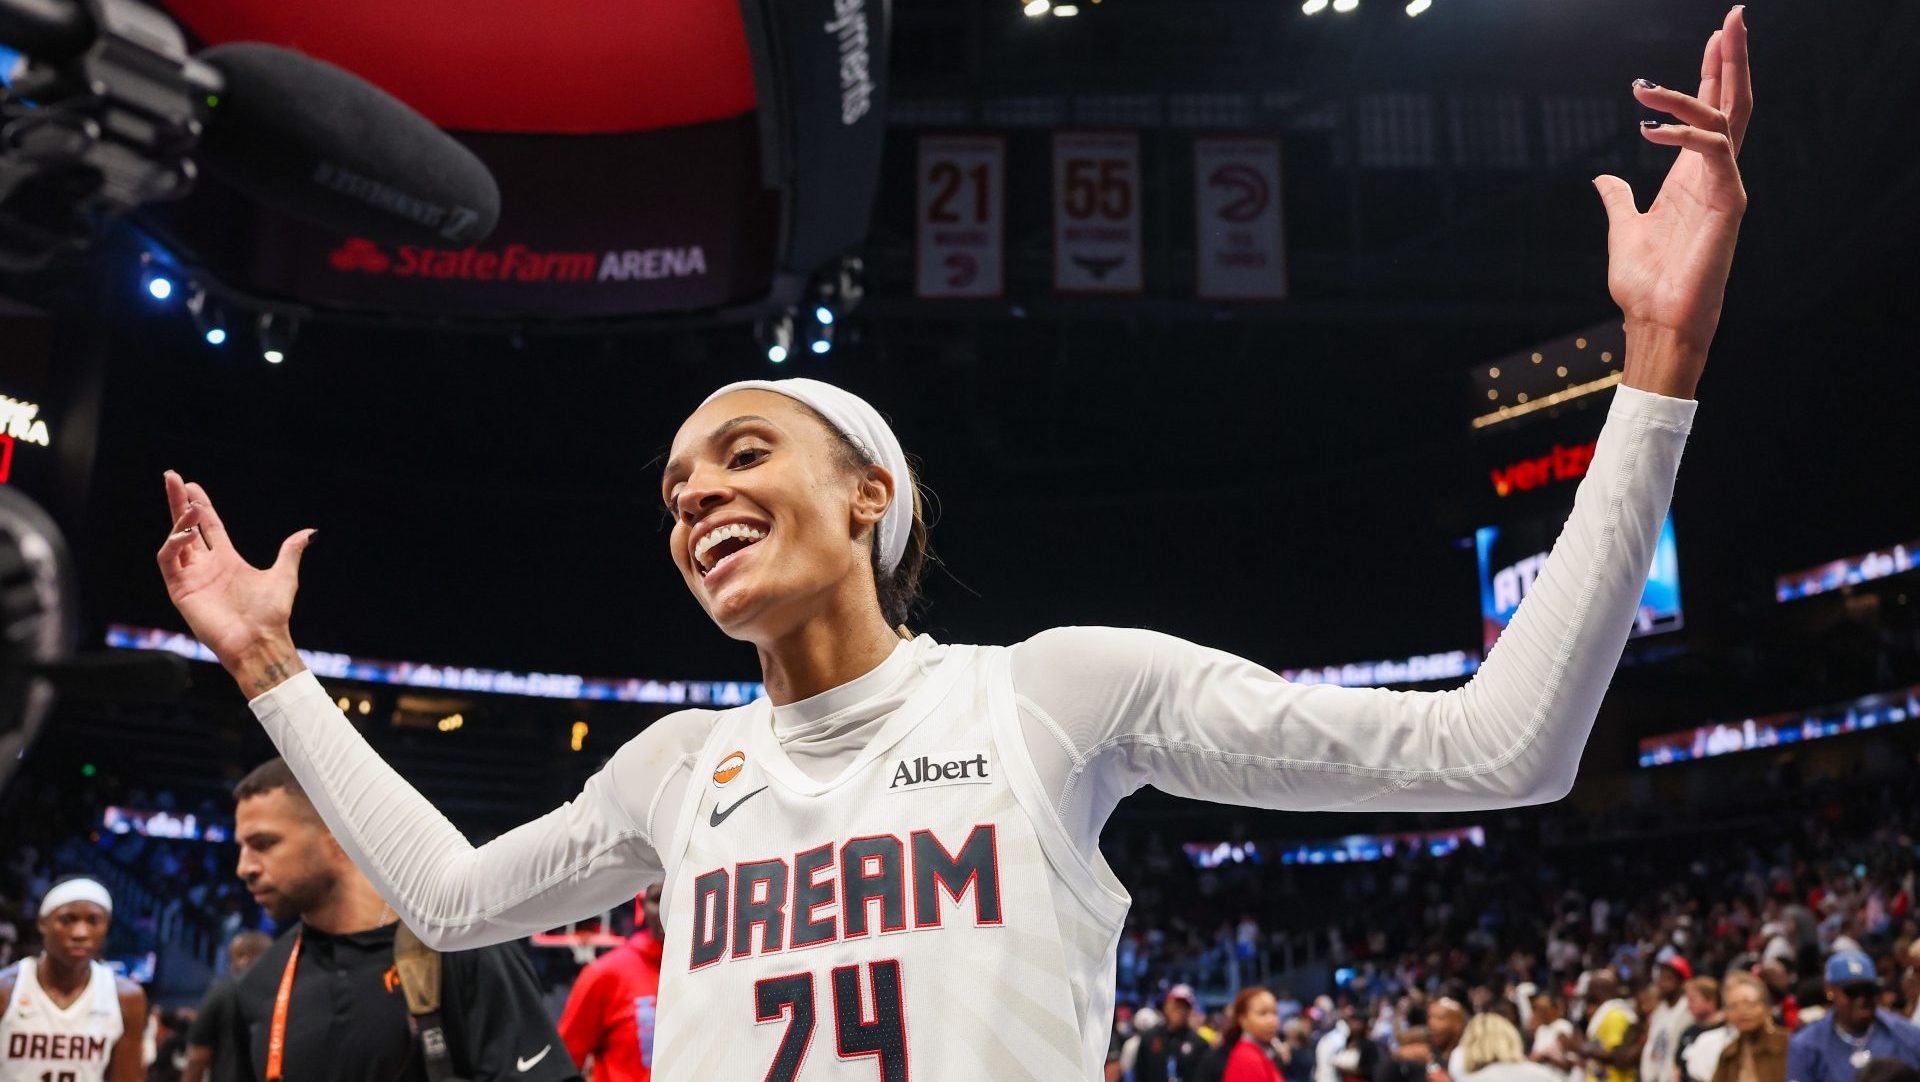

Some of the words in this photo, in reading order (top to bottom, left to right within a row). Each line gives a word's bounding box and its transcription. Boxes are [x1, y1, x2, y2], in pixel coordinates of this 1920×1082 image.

[928, 160, 990, 223] 21
[1064, 160, 1130, 220] 55
[598, 245, 706, 282] ARENA
[1490, 439, 1598, 496] veriz
[889, 753, 989, 789] Albert
[689, 823, 1004, 972] DREAM
[8, 1033, 107, 1060] DREAM
[753, 957, 910, 1082] 24
